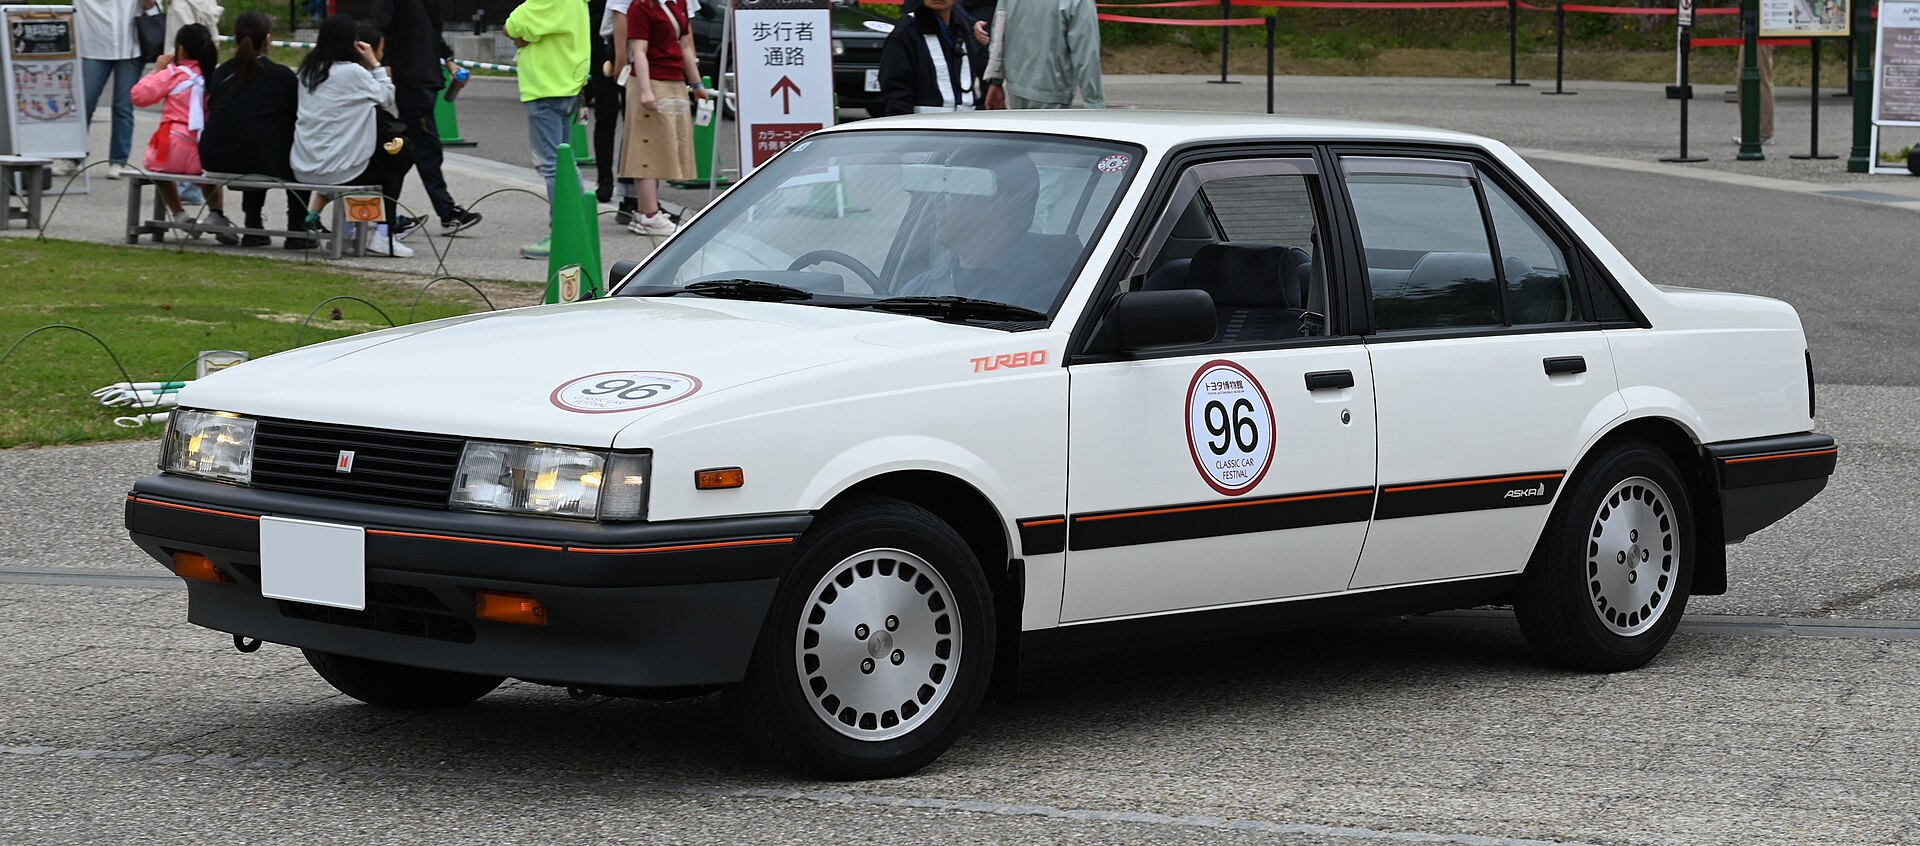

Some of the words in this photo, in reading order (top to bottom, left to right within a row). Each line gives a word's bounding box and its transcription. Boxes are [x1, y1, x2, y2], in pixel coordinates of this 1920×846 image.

[752, 21, 814, 42] 歩行者
[764, 47, 805, 66] 通路
[970, 349, 1046, 373] TURBO
[582, 379, 672, 400] 96
[1205, 380, 1244, 392] トヨタ博物館
[1204, 398, 1259, 456] 96
[1215, 459, 1241, 469] CLASSIC
[1241, 457, 1255, 468] CAR
[1222, 470, 1249, 480] FESTIVAL
[1503, 488, 1538, 499] ASKA
